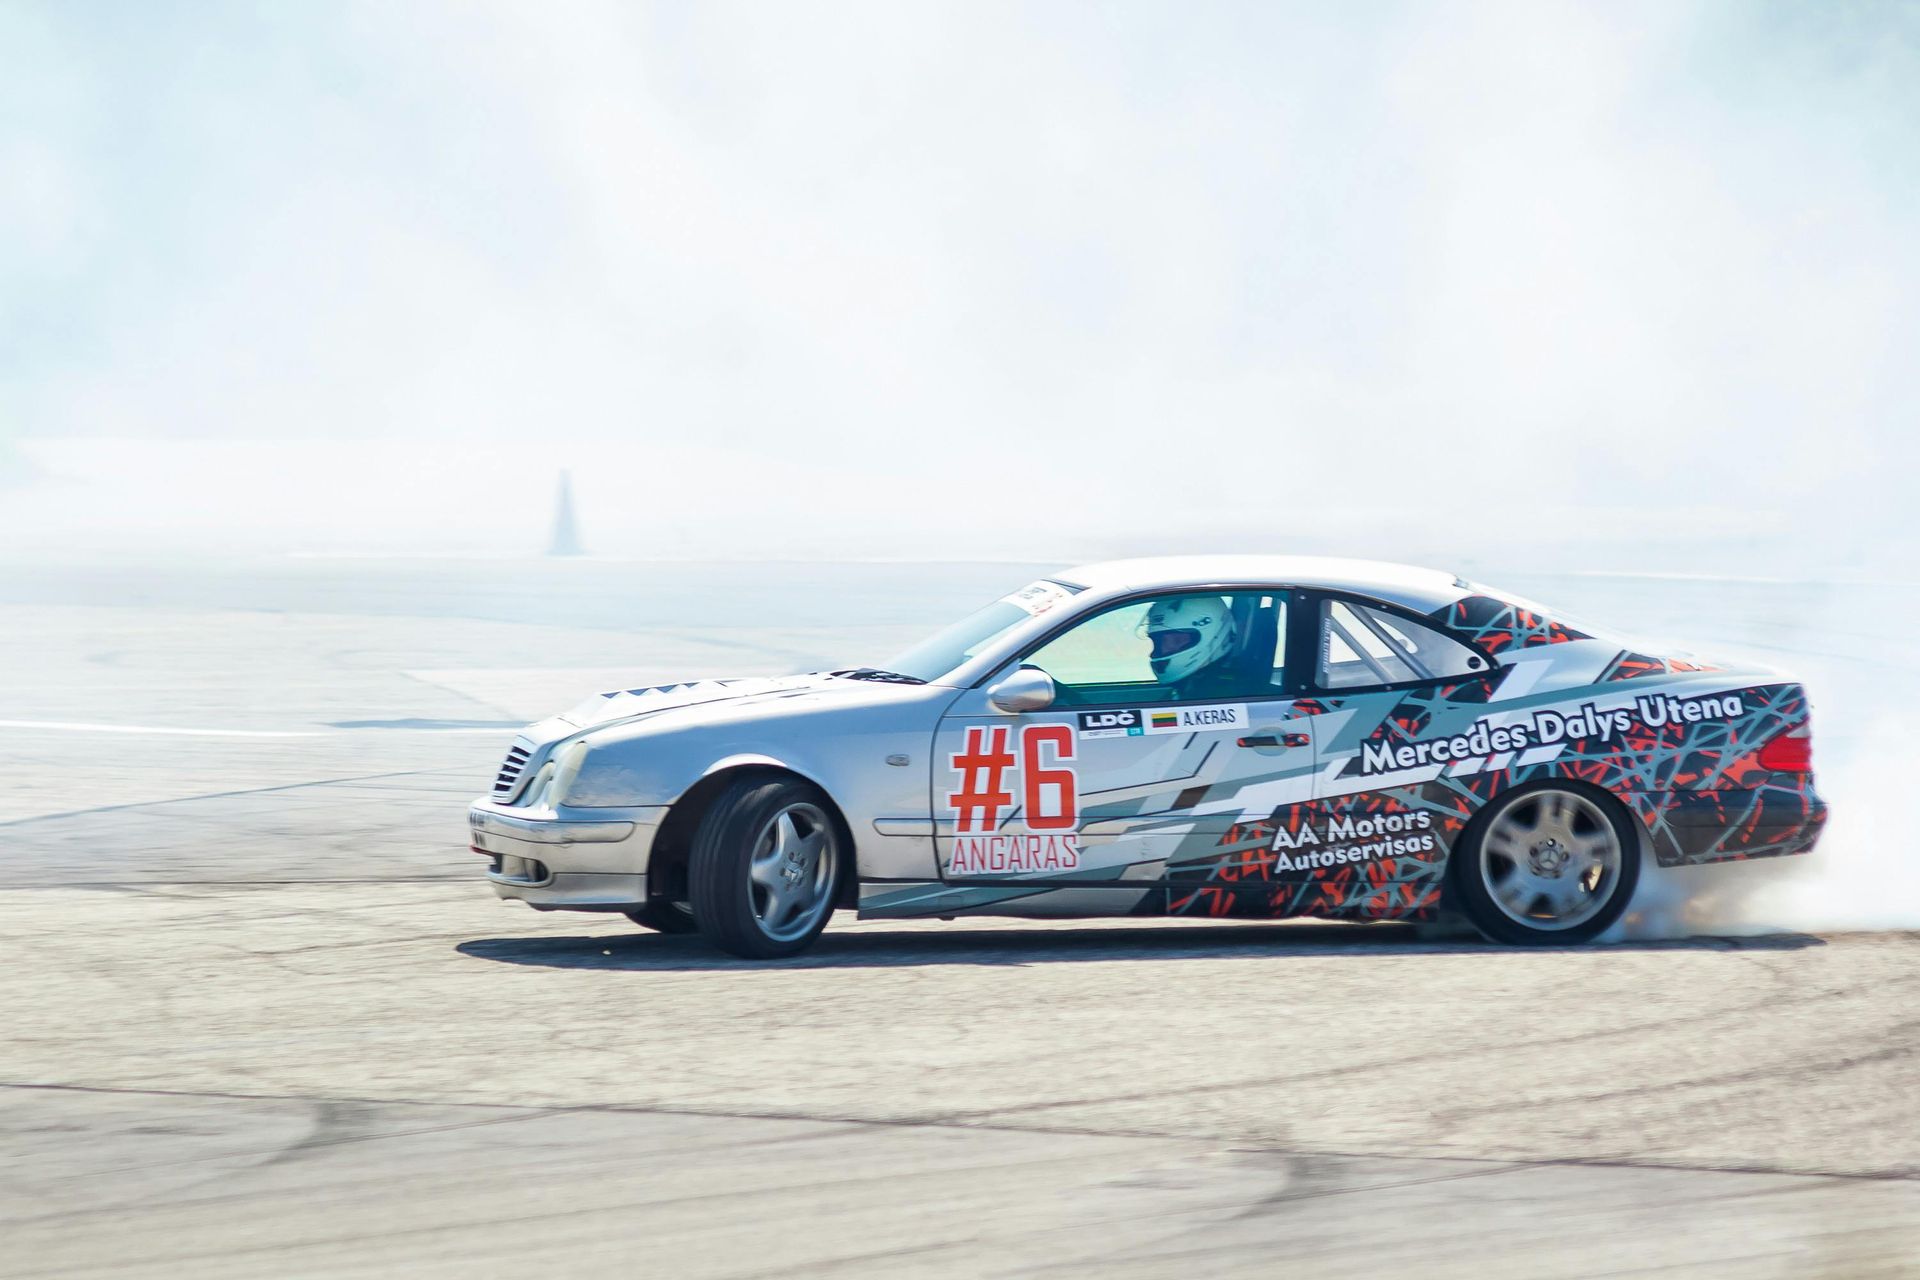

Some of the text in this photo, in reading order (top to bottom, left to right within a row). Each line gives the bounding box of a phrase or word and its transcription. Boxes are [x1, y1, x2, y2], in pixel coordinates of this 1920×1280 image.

[1362, 695, 1744, 774] Mercedes Dalys Utena
[949, 725, 1076, 833] #6
[1271, 811, 1431, 851] AA Motors
[952, 834, 1077, 872] ANGARAS
[1274, 835, 1434, 875] Autoservisas
